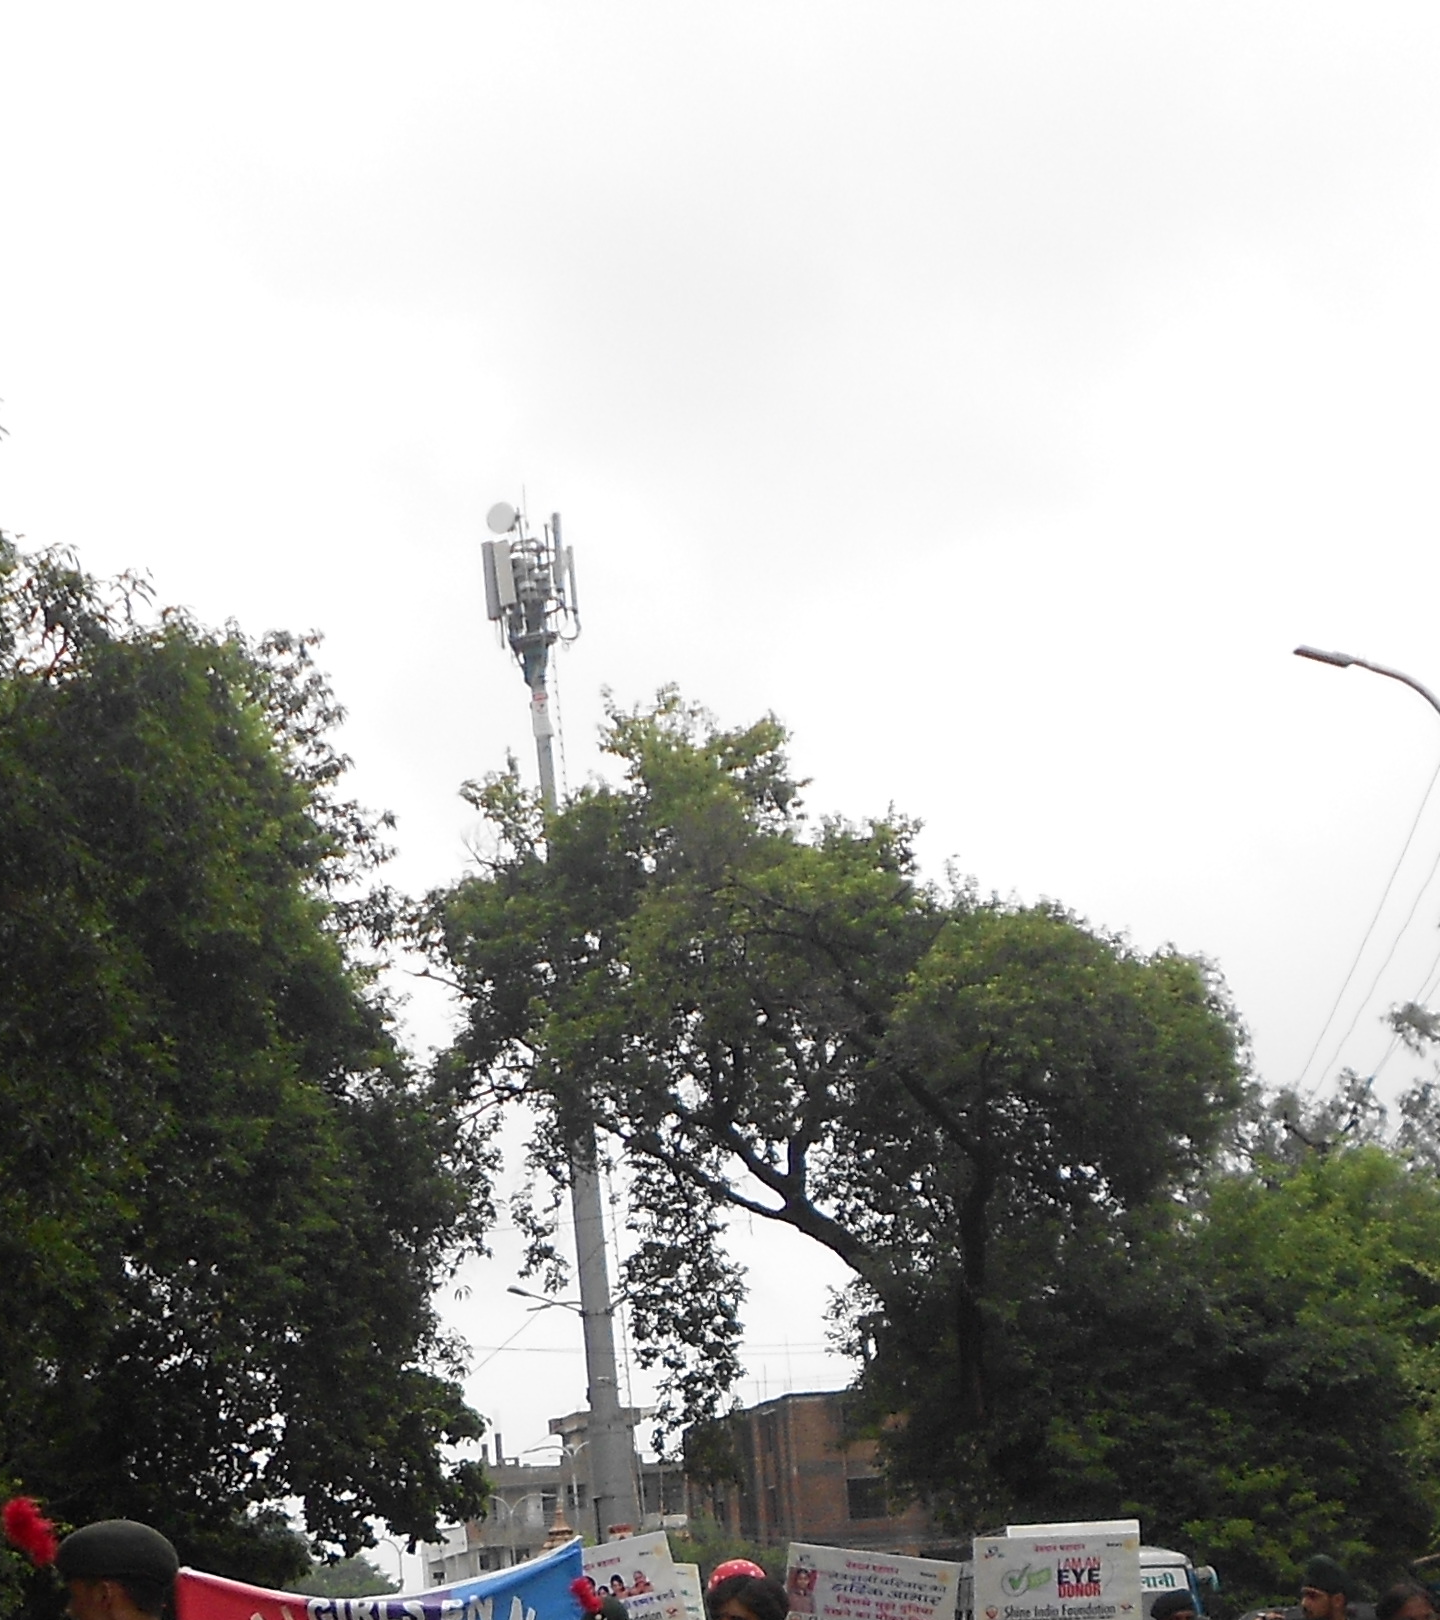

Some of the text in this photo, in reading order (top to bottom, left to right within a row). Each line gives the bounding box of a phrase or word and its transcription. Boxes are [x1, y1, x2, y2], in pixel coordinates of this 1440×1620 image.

[1063, 1557, 1084, 1570] AM
[1085, 1556, 1101, 1569] AN
[1057, 1568, 1101, 1585] EYE
[1057, 1583, 1101, 1599] DONOR
[1062, 1601, 1116, 1616] Foundation
